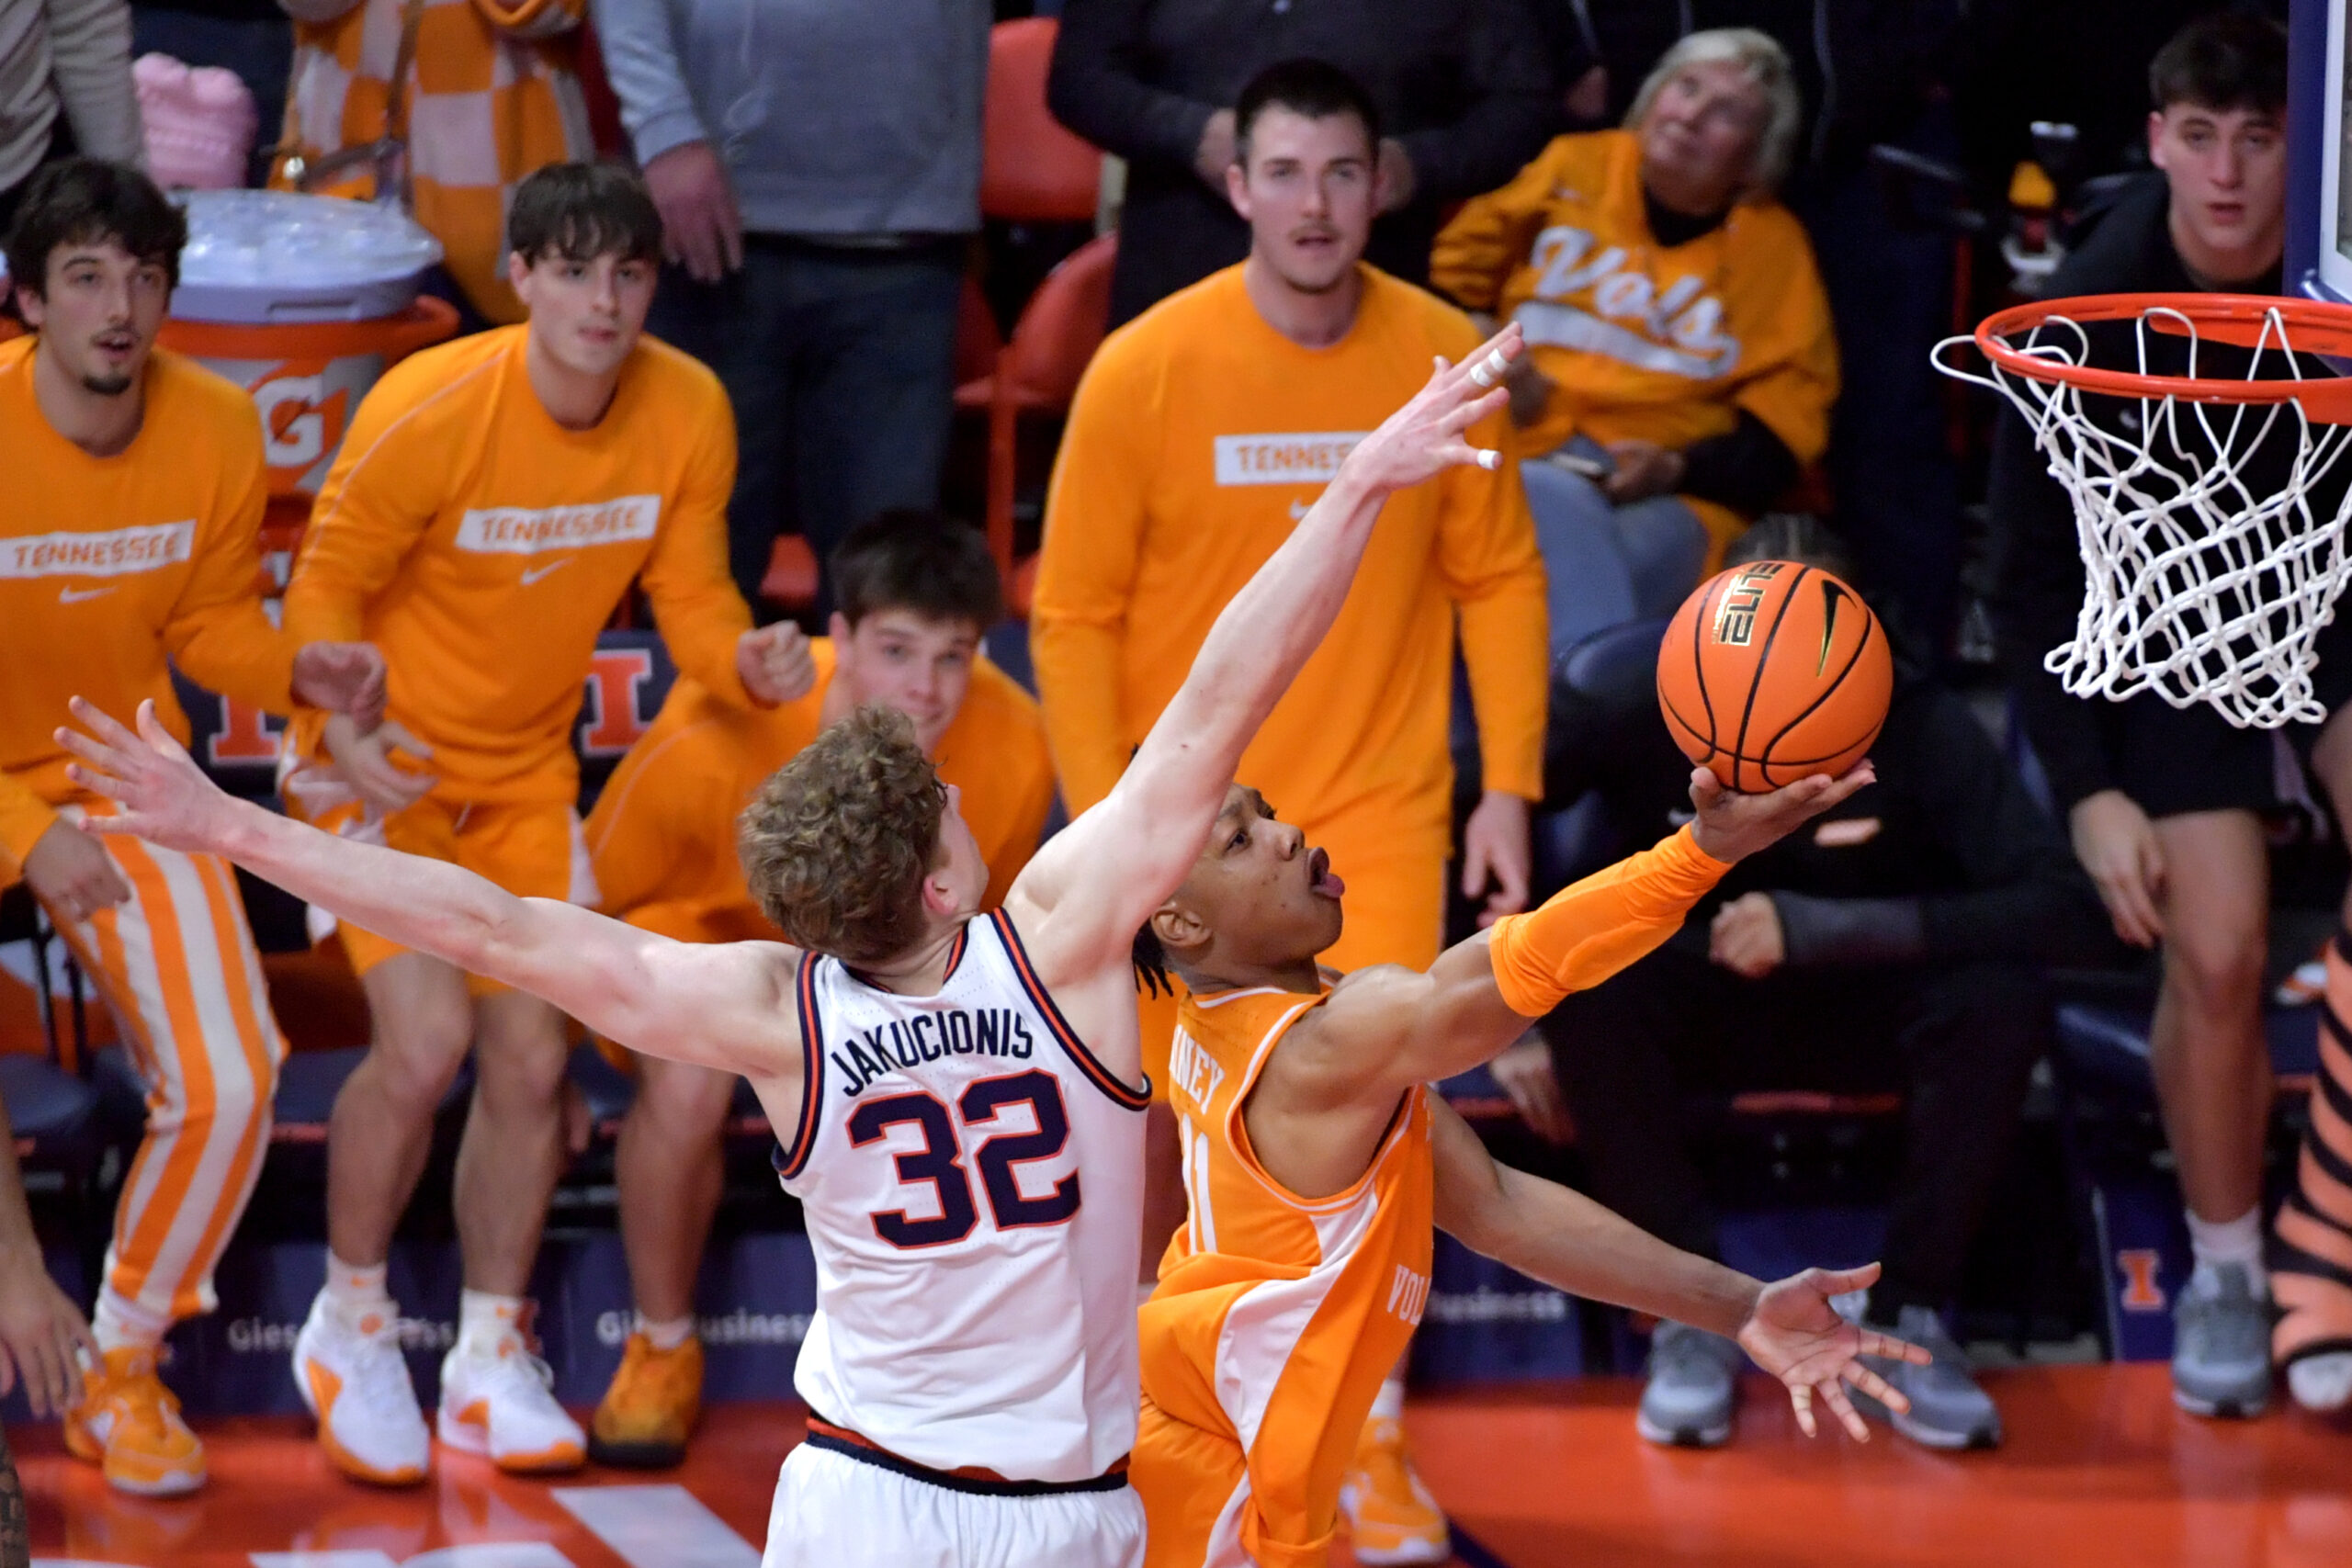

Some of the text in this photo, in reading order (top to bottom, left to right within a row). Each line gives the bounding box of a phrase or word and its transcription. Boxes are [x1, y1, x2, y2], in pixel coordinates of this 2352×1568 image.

[1531, 226, 1727, 350] Vols
[15, 532, 178, 568] TENNESSEE
[482, 506, 641, 541] TENNESSEE
[831, 1008, 1033, 1098] JAKUCIONIS
[844, 1066, 1082, 1250] 32
